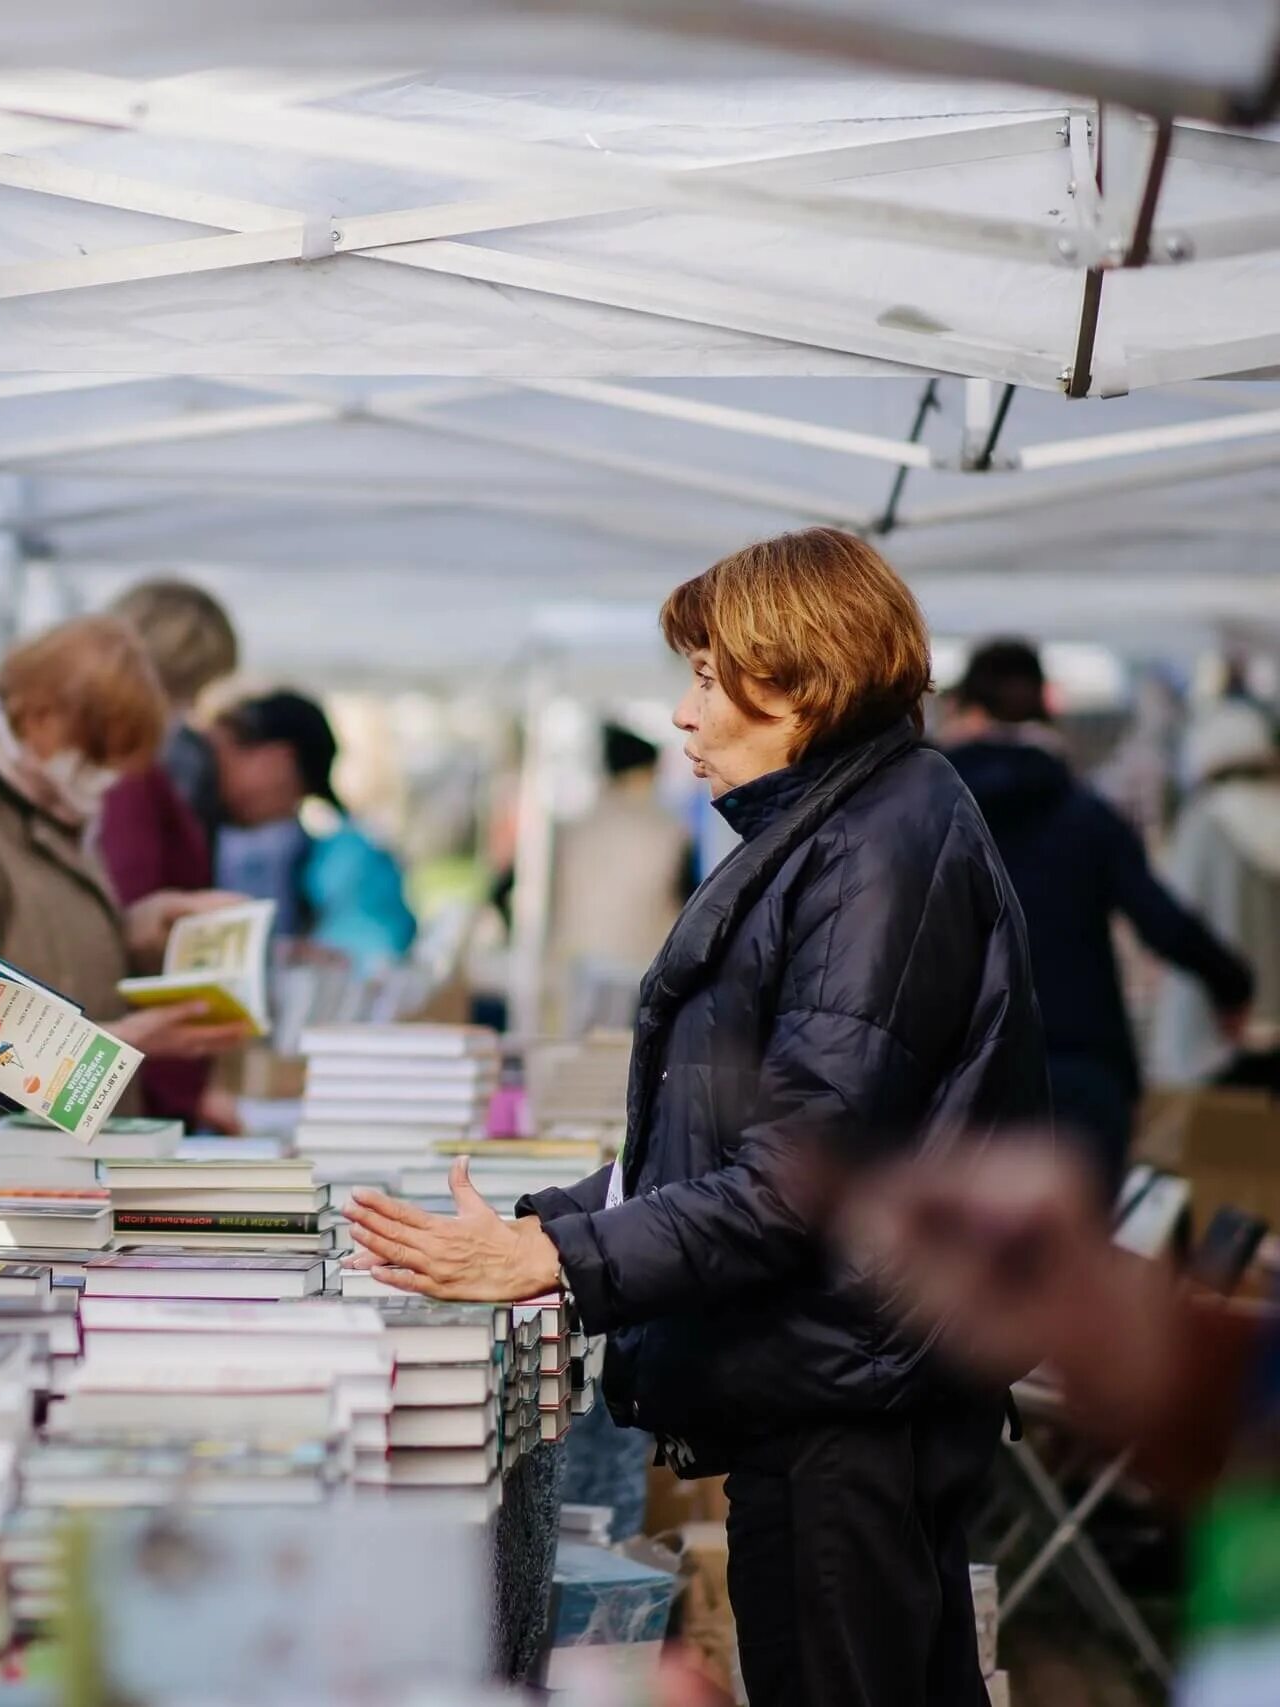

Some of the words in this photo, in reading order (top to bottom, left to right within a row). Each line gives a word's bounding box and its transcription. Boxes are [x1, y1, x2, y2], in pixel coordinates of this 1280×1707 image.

[63, 1049, 105, 1113] МУЗЫКАЛЬНАЯ
[66, 1061, 87, 1090] СЦЕНА
[76, 1064, 104, 1105] ГЛАВНАЯ
[91, 1072, 119, 1111] АВГУСТА
[117, 1215, 145, 1223] ЛЮДИ
[148, 1215, 212, 1224] НОРМАЛЬНЫЕ
[218, 1216, 246, 1226] РУНИ
[250, 1217, 288, 1226] САЛЛИ
